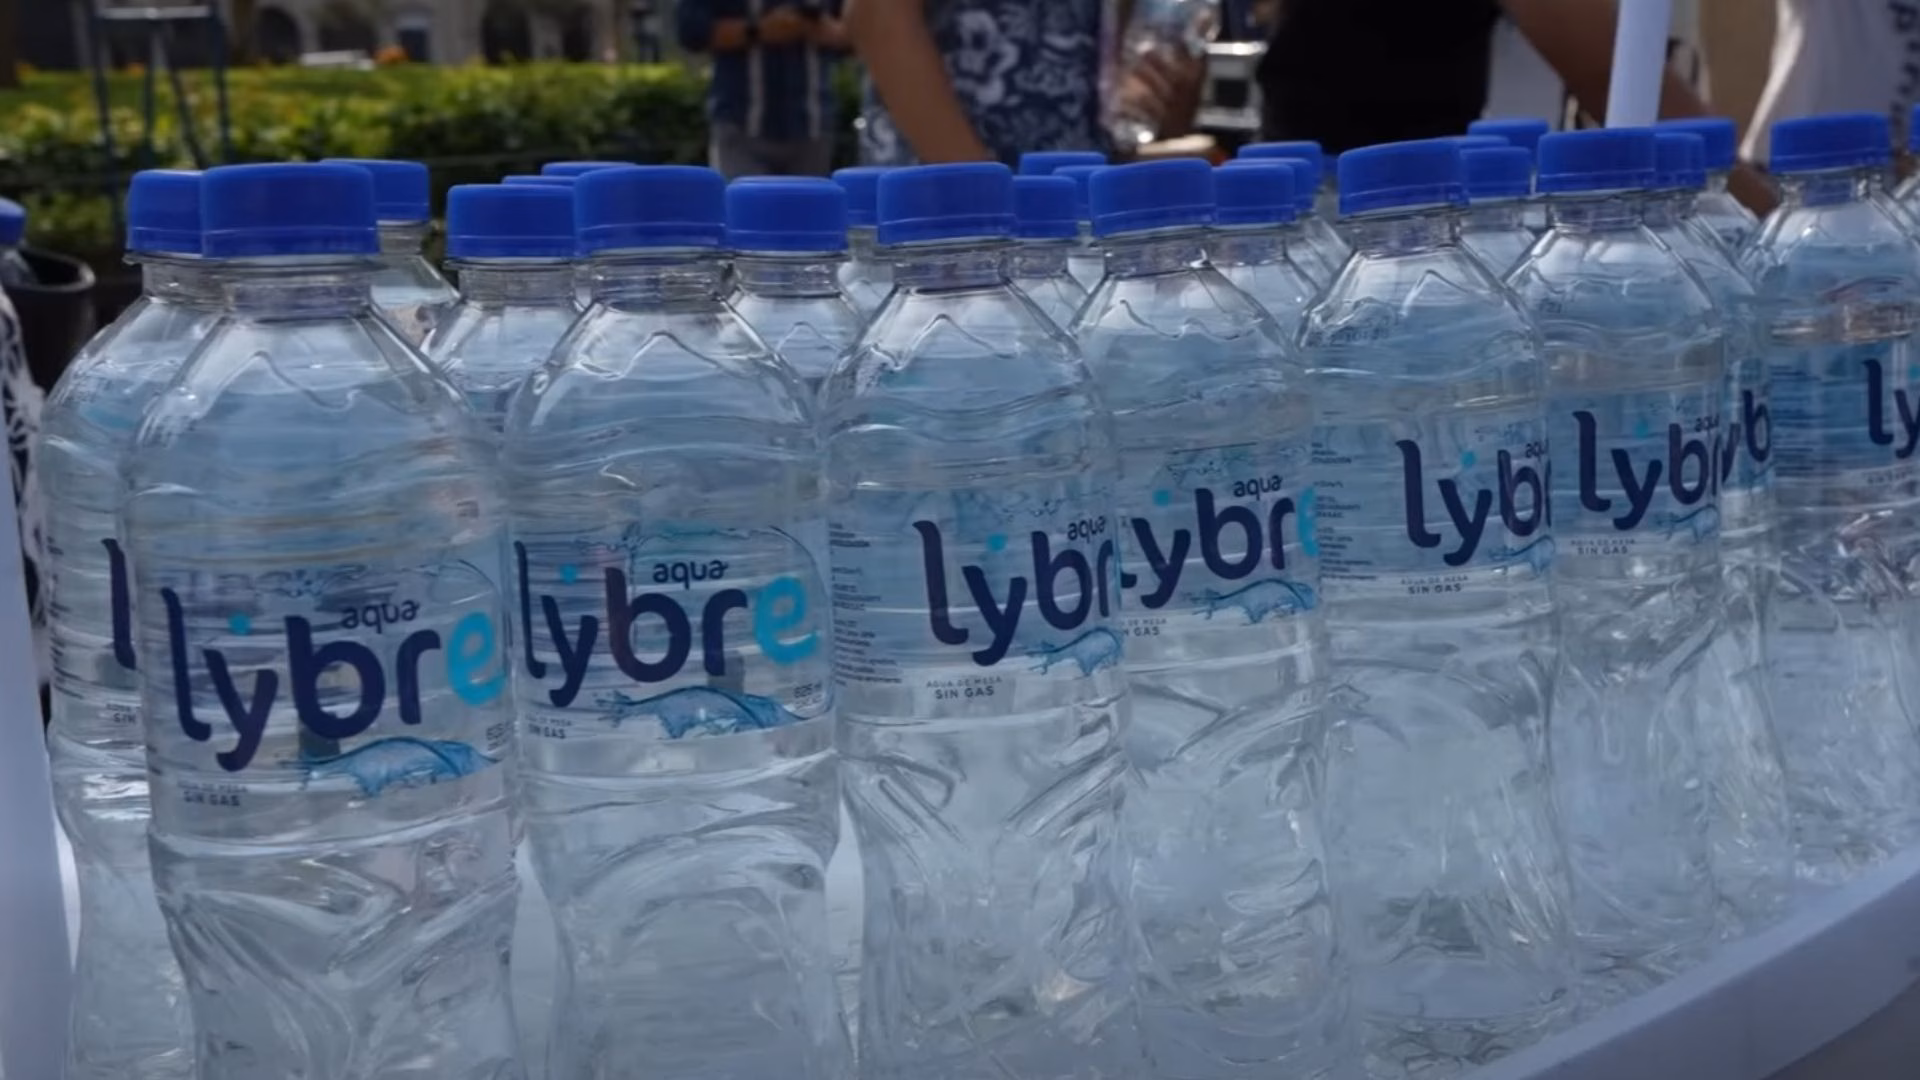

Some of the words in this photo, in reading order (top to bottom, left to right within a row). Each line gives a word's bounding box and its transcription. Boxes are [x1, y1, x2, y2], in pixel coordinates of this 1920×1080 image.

[1233, 473, 1283, 500] aqua
[653, 557, 729, 589] aqua
[1408, 585, 1430, 595] SIN
[1434, 582, 1461, 593] GAS
[341, 599, 421, 634] aqua
[514, 539, 820, 708] lybre
[1133, 626, 1161, 637] GAS
[161, 586, 508, 773] lybre
[935, 689, 959, 700] SIN
[964, 685, 995, 698] GAS
